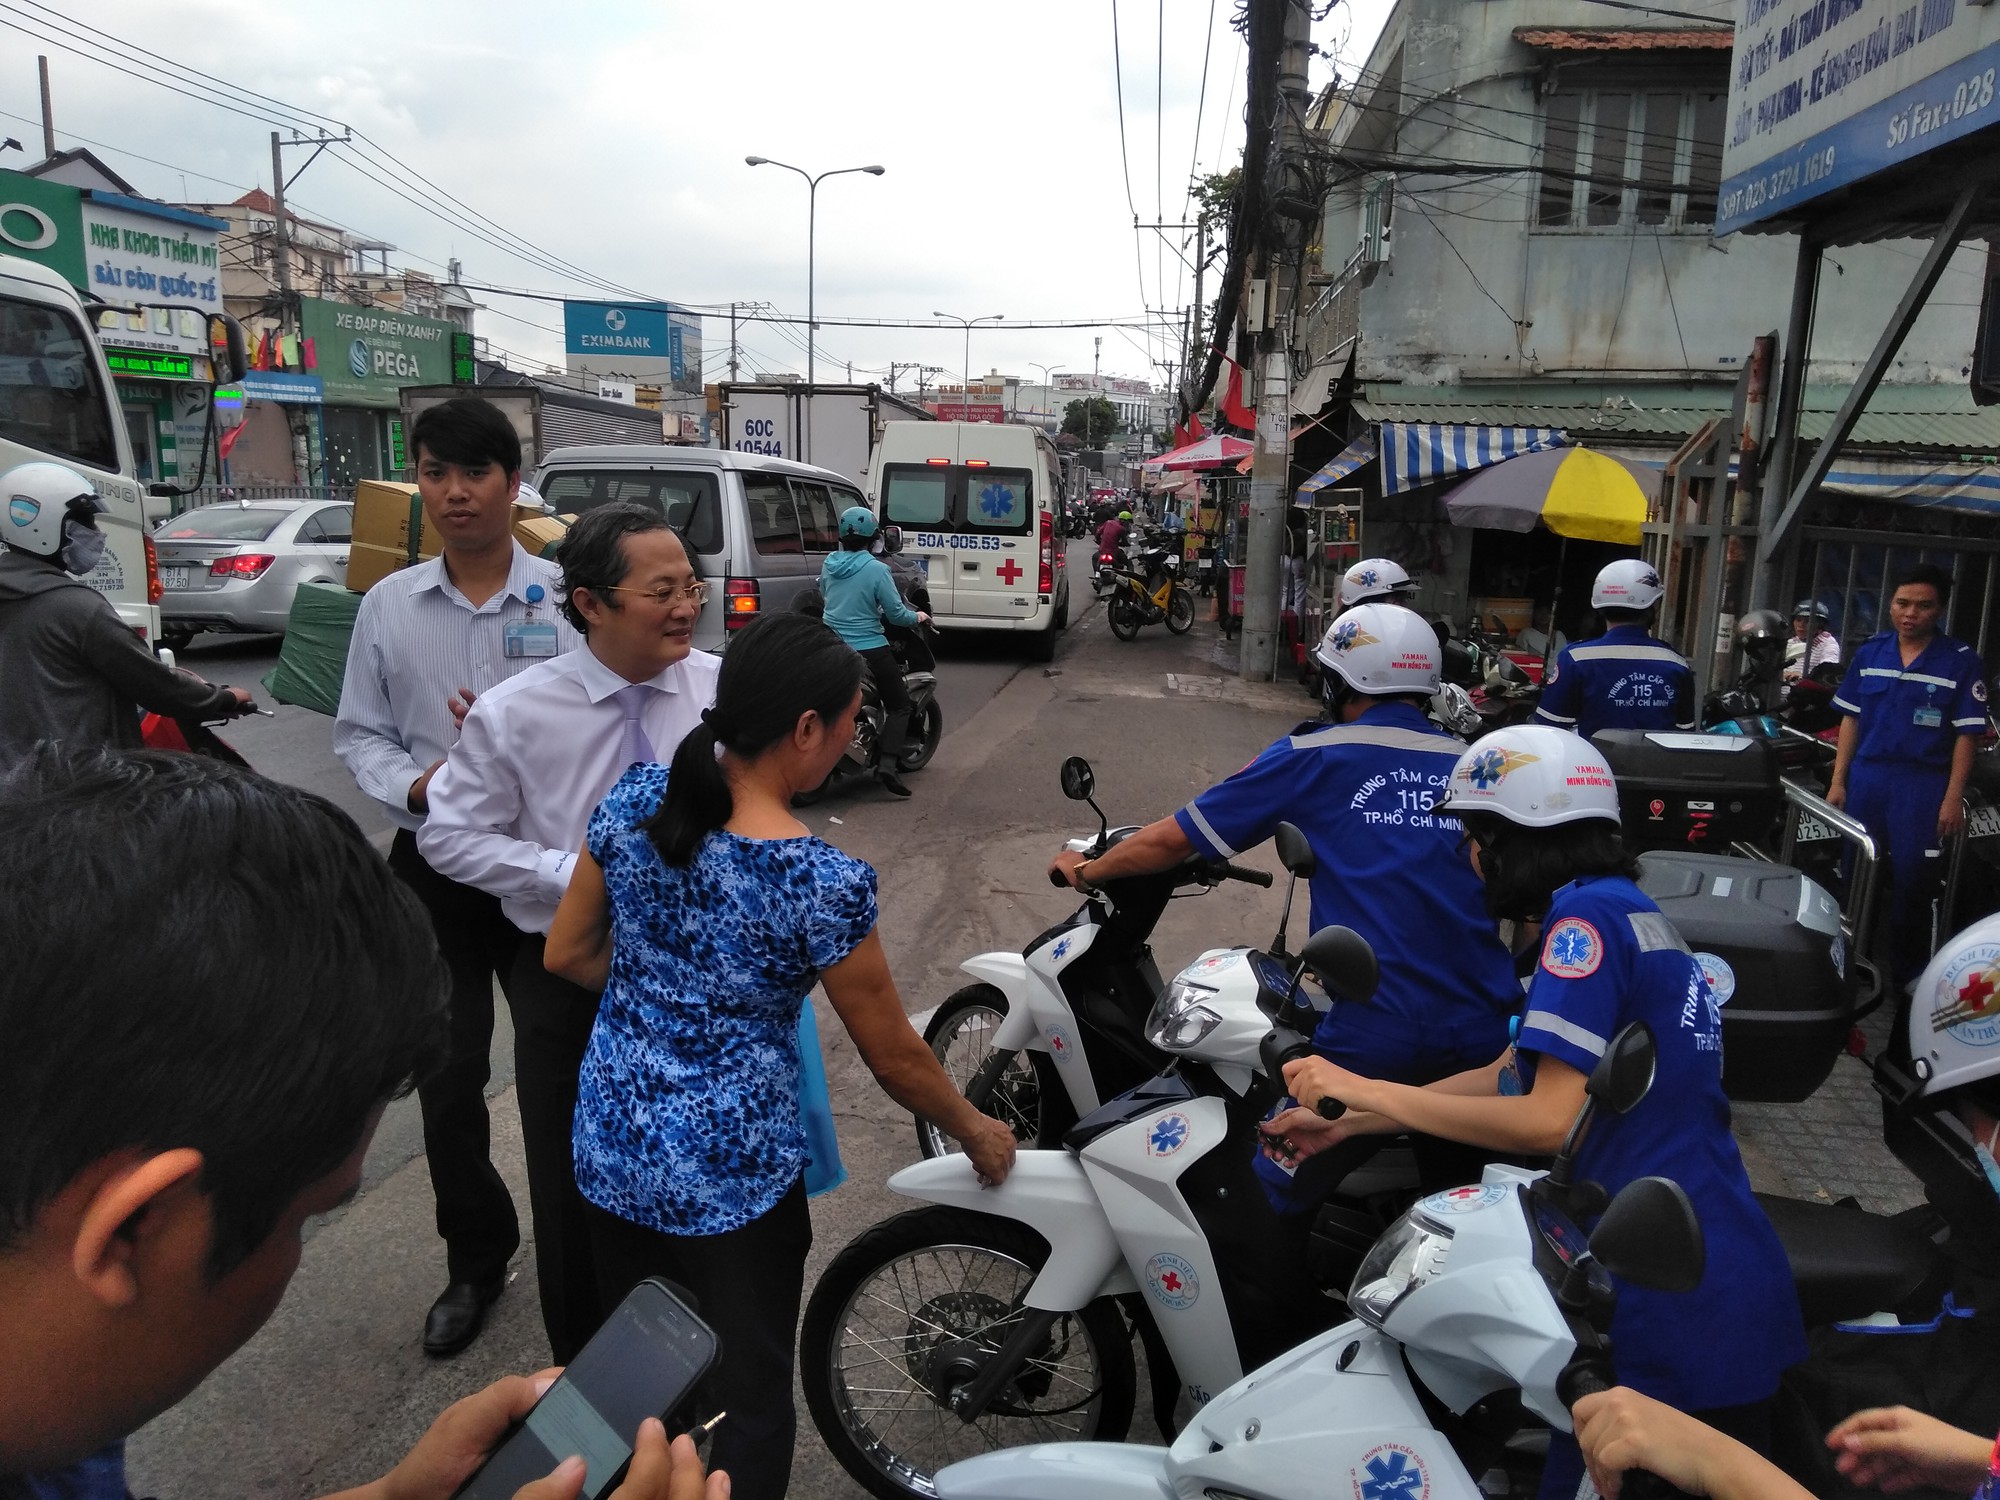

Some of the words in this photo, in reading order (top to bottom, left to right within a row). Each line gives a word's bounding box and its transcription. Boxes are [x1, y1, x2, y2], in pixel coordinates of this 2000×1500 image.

[1886, 102, 1914, 149] Số
[1769, 161, 1800, 200] 3724
[1803, 145, 1835, 186] 1619
[90, 222, 119, 250] NHA
[123, 228, 160, 258] KHOA
[161, 232, 198, 265] THẨM
[126, 265, 156, 291] GÒN
[159, 271, 197, 298] QUỐC
[199, 276, 216, 301] TẾ
[336, 312, 351, 329] XE
[354, 316, 378, 335] ĐẠP
[380, 317, 405, 339] ĐIỆN
[405, 323, 436, 342] XANH
[436, 329, 443, 342] 7
[582, 334, 651, 349] EXIMBANK
[373, 350, 420, 378] PEGA
[745, 419, 774, 437] 60C
[735, 439, 782, 458] 10544
[917, 533, 1000, 550] 50A-005.53
[166, 567, 182, 578] 61A
[1402, 653, 1427, 661] YAMAHA
[1608, 677, 1628, 700] TRUNG
[1629, 672, 1646, 682] TÂM
[1648, 674, 1665, 686] CẤP
[1632, 684, 1653, 697] 115
[1637, 697, 1651, 707] CHÍ
[1574, 765, 1605, 775] YAMAHA
[1350, 774, 1387, 810] TRUNG
[1389, 768, 1422, 783] TÂM
[1566, 777, 1585, 787] MINH
[1397, 789, 1435, 811] 115
[1410, 814, 1434, 828] CHÍ
[1157, 1256, 1178, 1265] BỆNH
[1179, 1261, 1194, 1280] VIỆN
[1189, 1384, 1211, 1405] CẤP
[1362, 1445, 1383, 1462] TRUNG
[1399, 1445, 1414, 1456] CẤP
[1413, 1454, 1425, 1469] CỨU
[1422, 1469, 1430, 1481] 115
